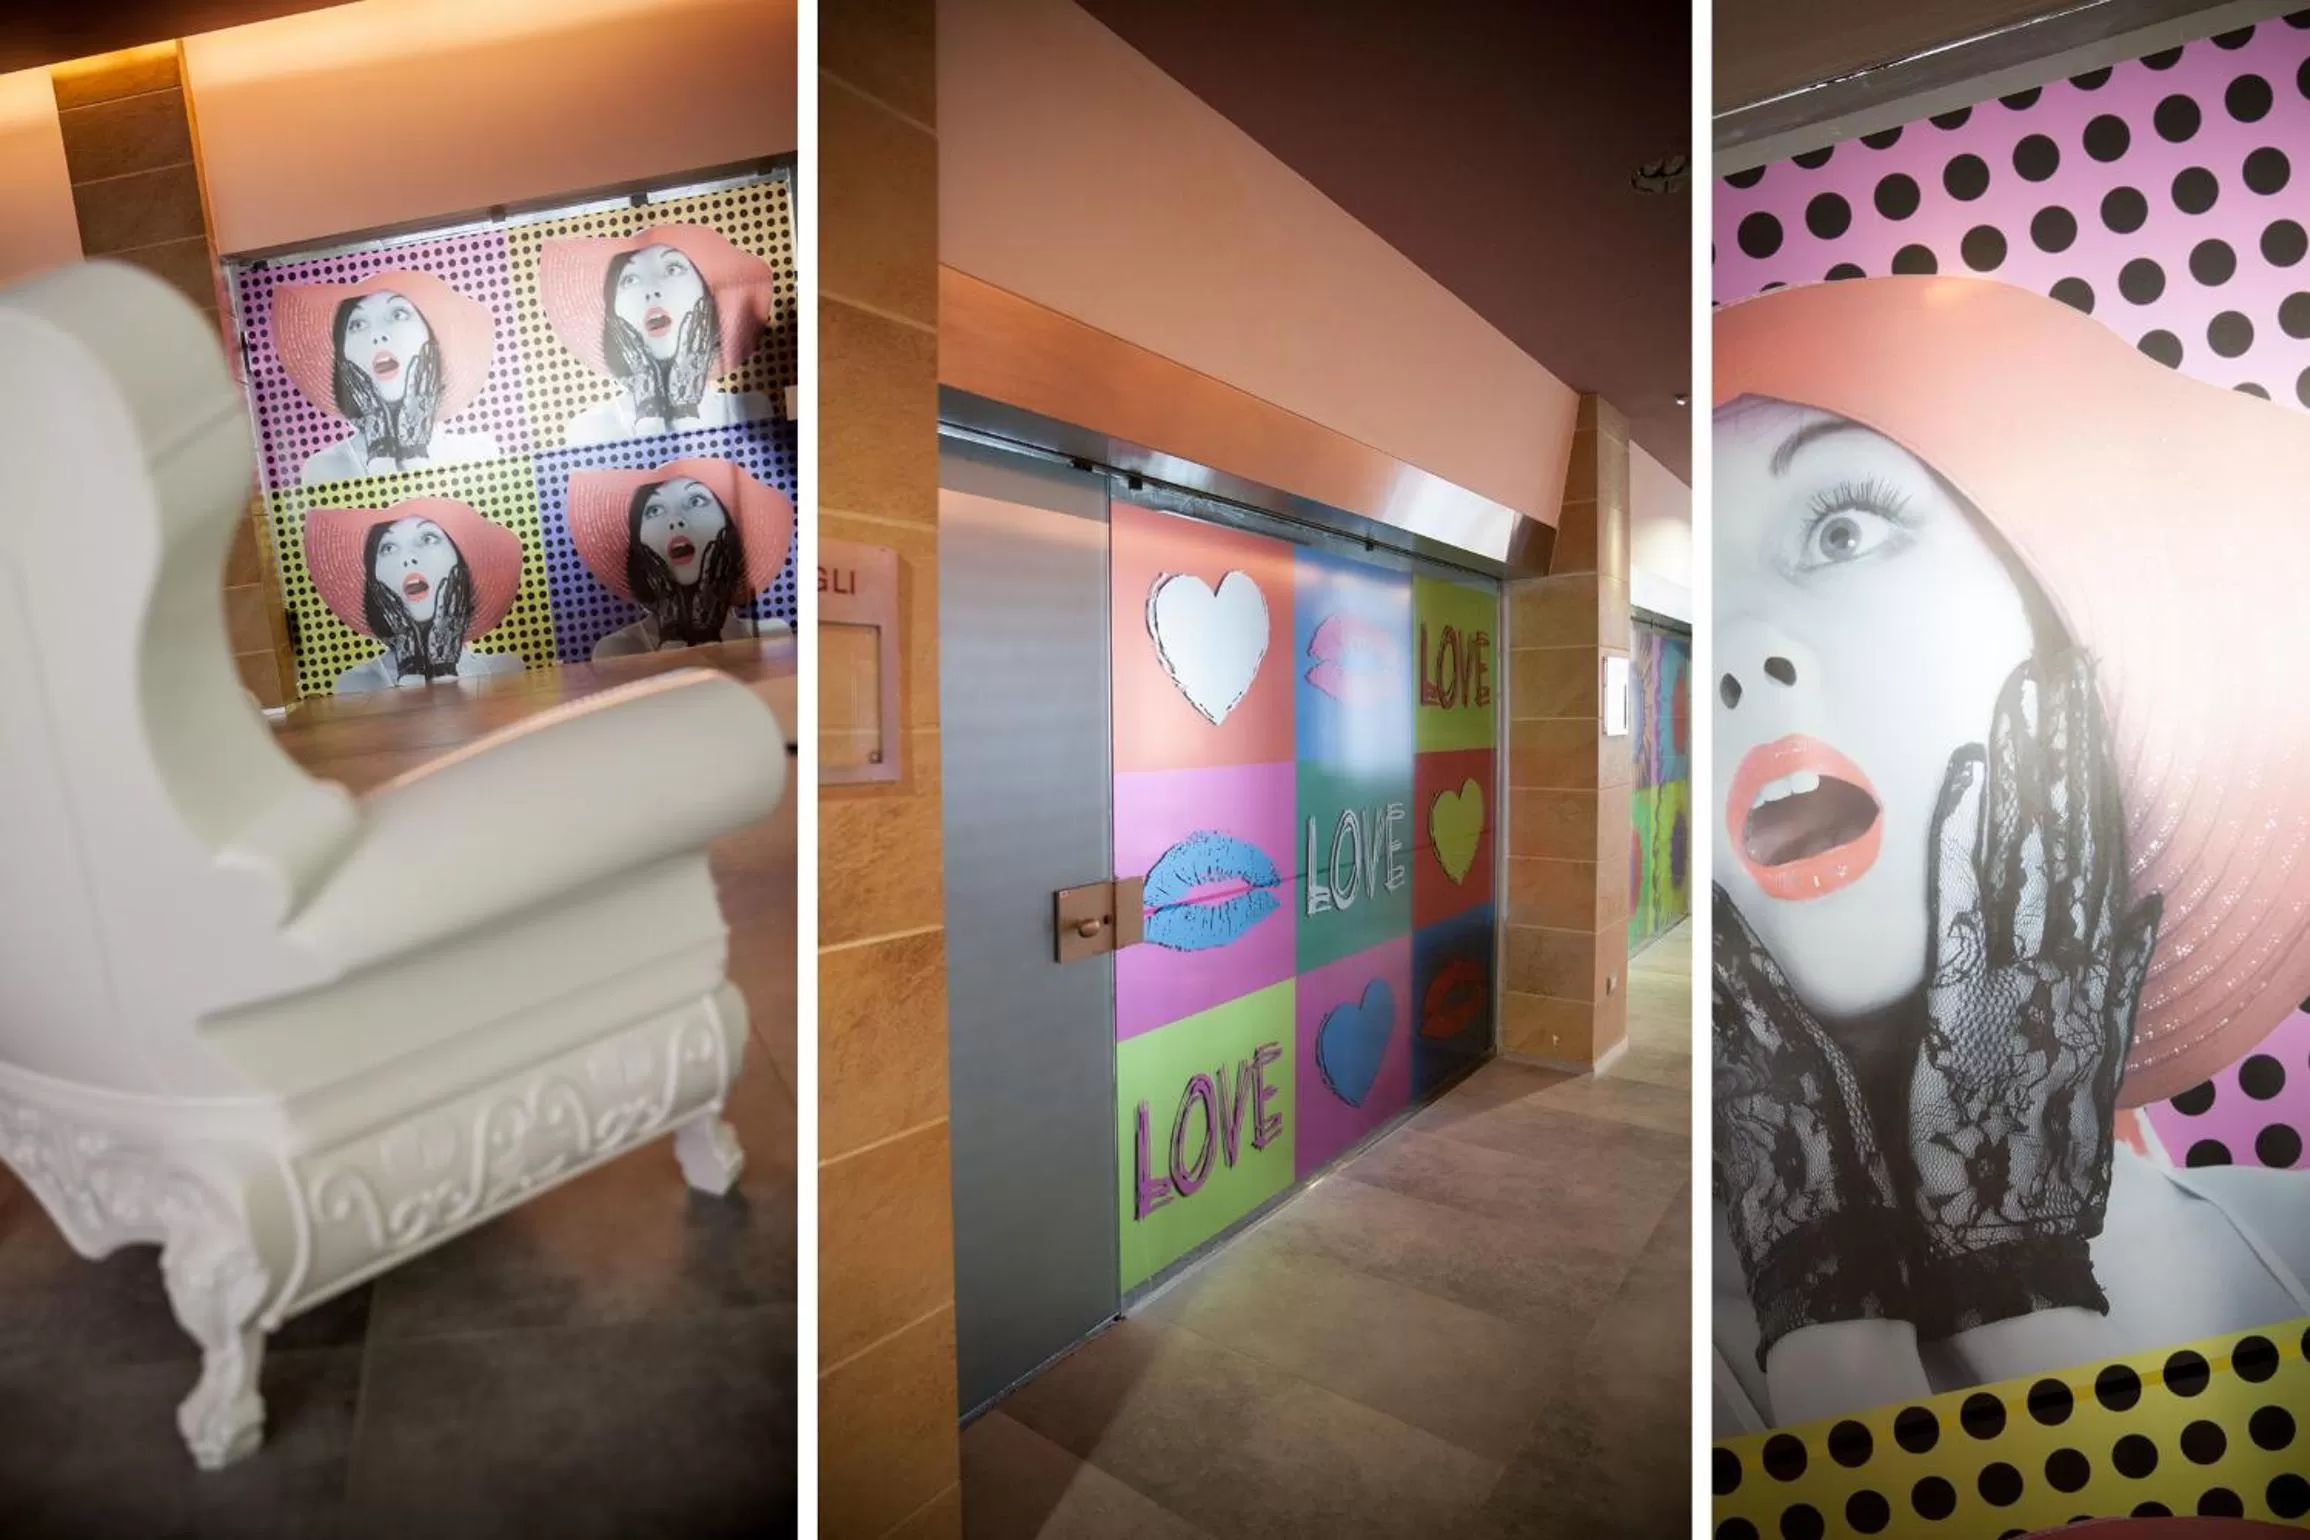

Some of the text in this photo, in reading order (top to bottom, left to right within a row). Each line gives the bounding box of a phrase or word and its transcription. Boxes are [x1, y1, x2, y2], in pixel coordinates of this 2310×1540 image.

[1420, 624, 1490, 709] LOVE
[1306, 803, 1405, 917] LOVE
[1134, 1042, 1282, 1220] LOVE
